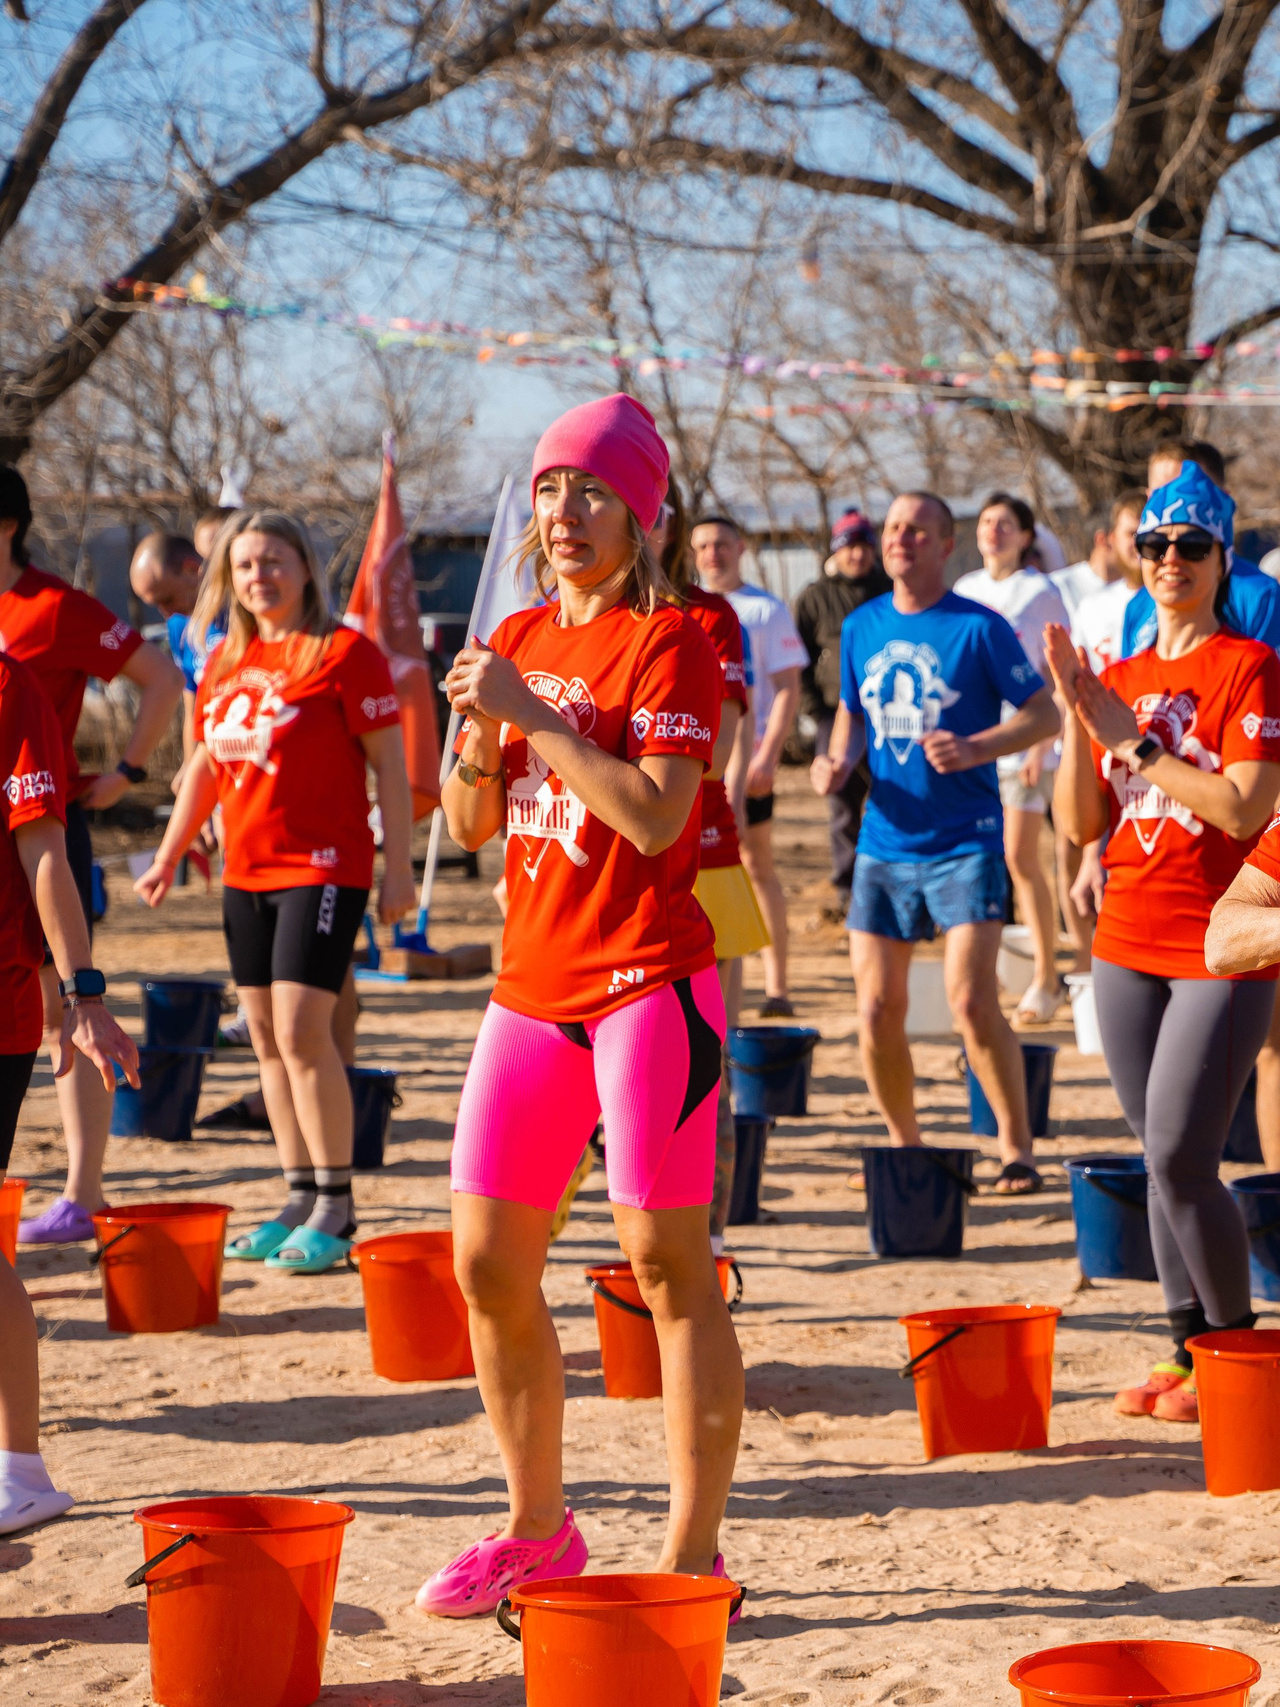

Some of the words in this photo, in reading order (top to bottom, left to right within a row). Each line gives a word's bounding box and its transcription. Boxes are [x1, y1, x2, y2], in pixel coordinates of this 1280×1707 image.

[528, 675, 561, 702] СЛАВА
[656, 712, 699, 727] ПУТЬ
[653, 724, 711, 743] ДОМОЙ
[24, 782, 56, 800] ДОМ
